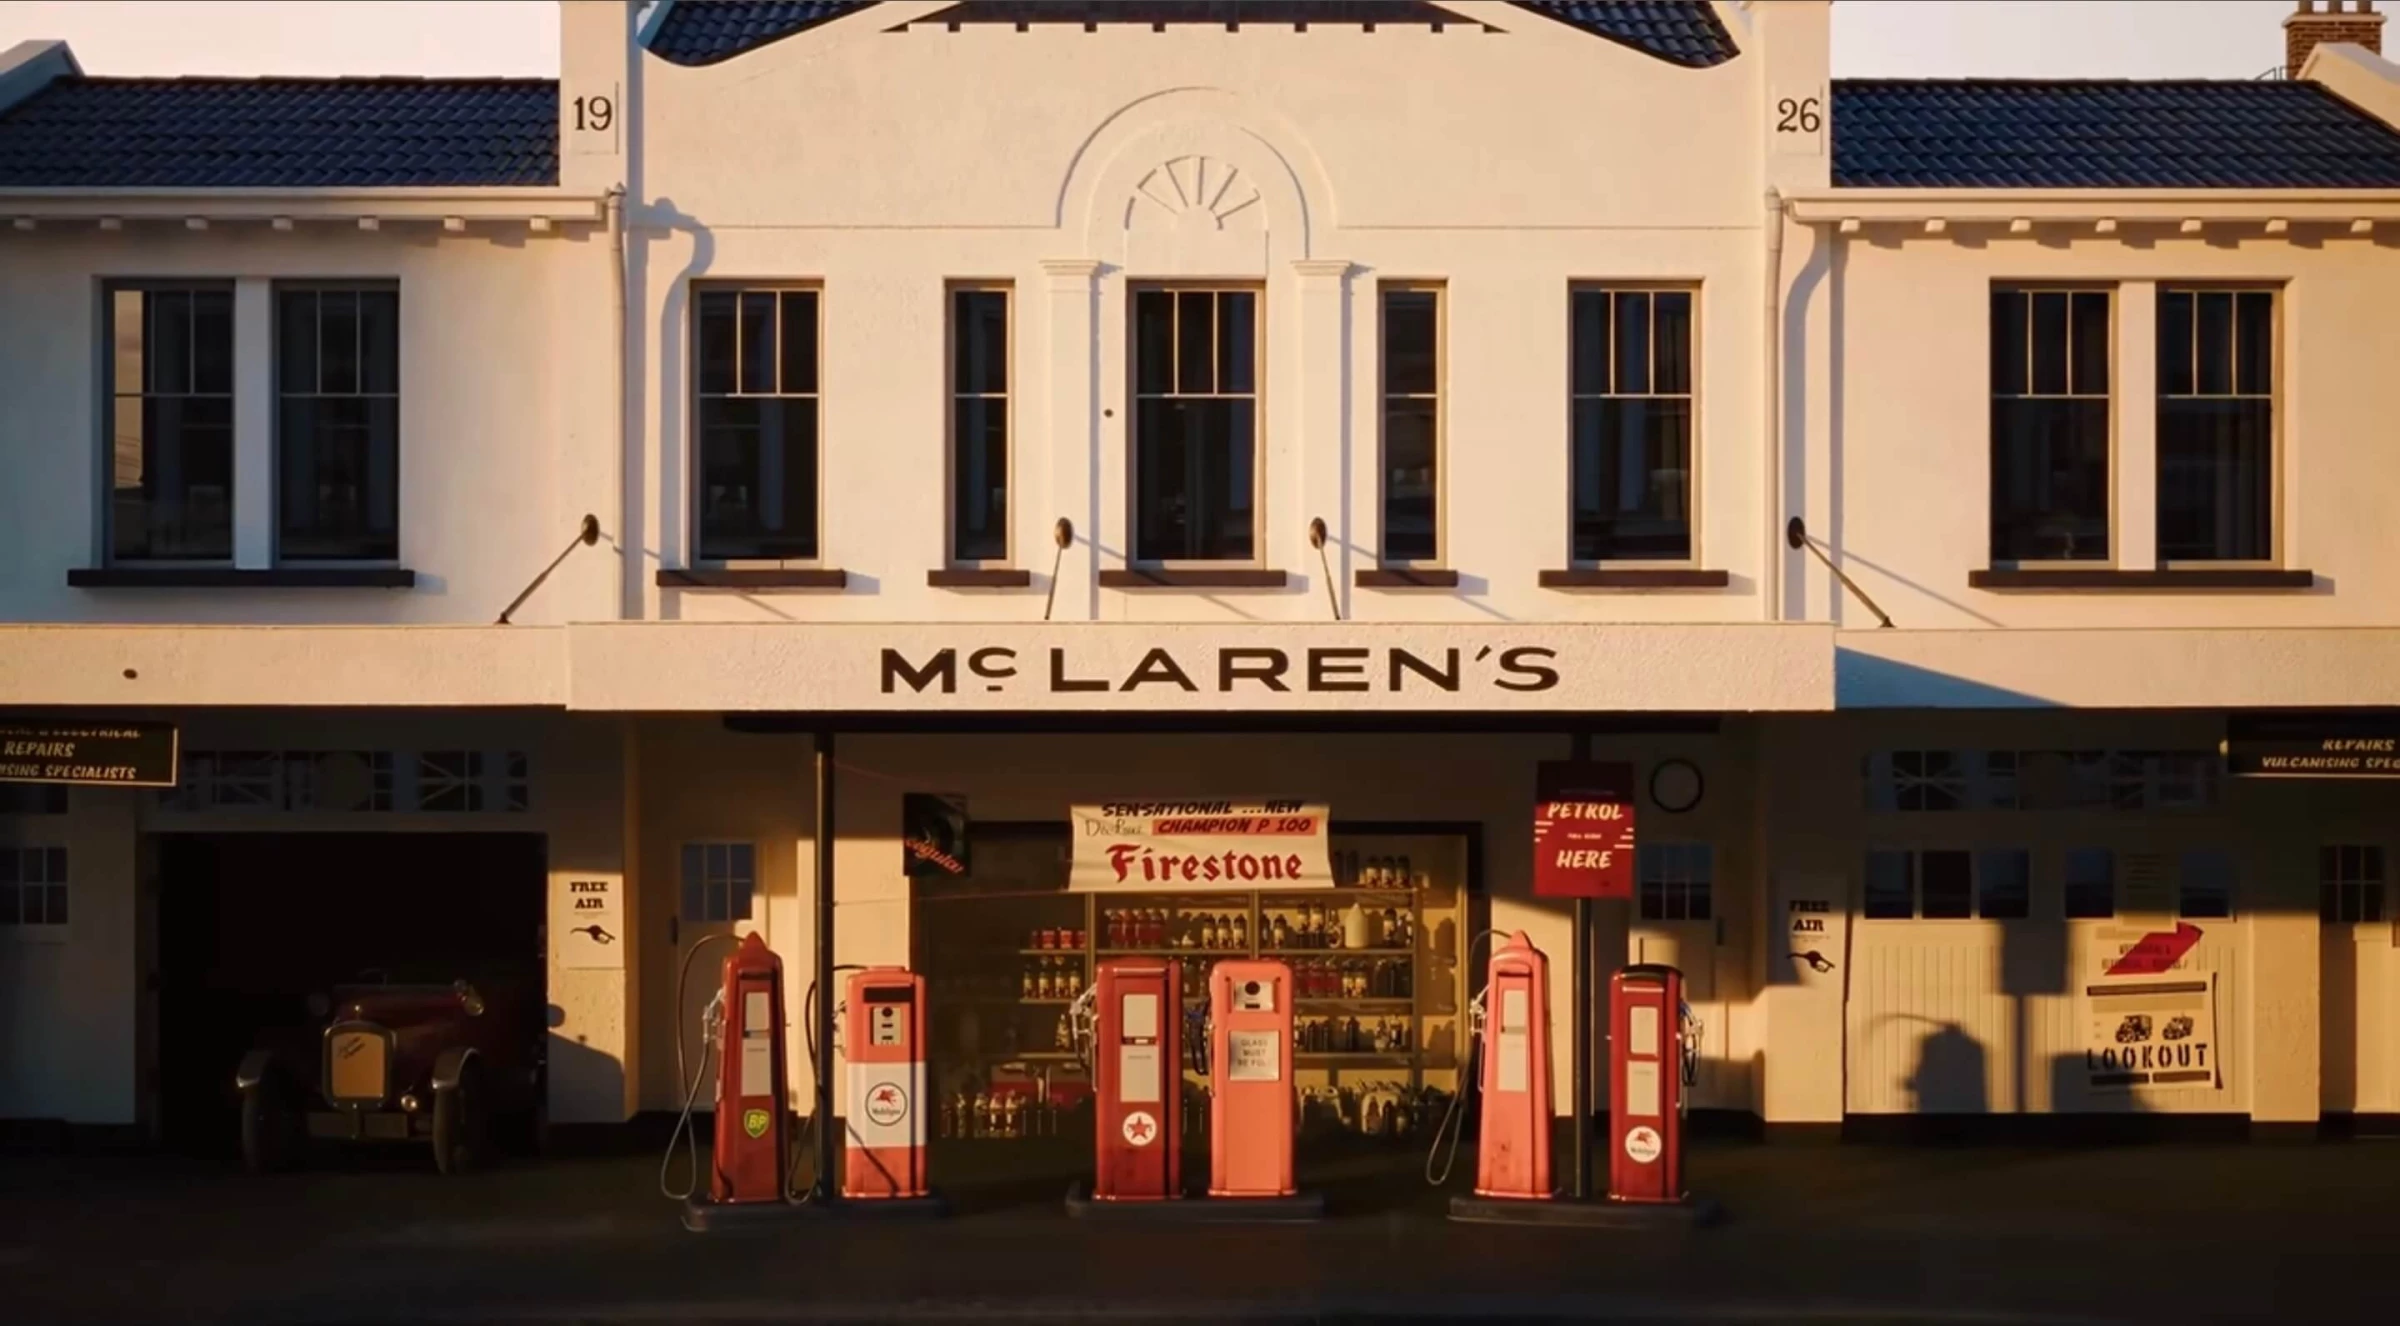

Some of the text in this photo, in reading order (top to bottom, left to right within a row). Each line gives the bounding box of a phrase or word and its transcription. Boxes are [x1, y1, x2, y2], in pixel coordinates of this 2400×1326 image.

[573, 96, 612, 131] 19
[1777, 98, 1820, 132] 26
[4, 740, 76, 757] REPAIRS
[2262, 757, 2360, 769] VULCANISING
[45, 764, 137, 780] SPECIALISTS
[1102, 801, 1232, 817] SENSATIONAL
[1547, 802, 1623, 820] PETROL
[1158, 819, 1249, 833] CHAMPION
[1256, 819, 1270, 832] P
[1276, 818, 1311, 832] 100
[1106, 844, 1302, 883] Firestone
[1556, 849, 1613, 869] HERE
[570, 881, 608, 893] FREE
[575, 898, 604, 909] AIR
[1789, 900, 1830, 912] FREE
[1793, 919, 1824, 931] AIR
[2087, 1043, 2207, 1070] LOOKOUT
[748, 1114, 767, 1130] BP
